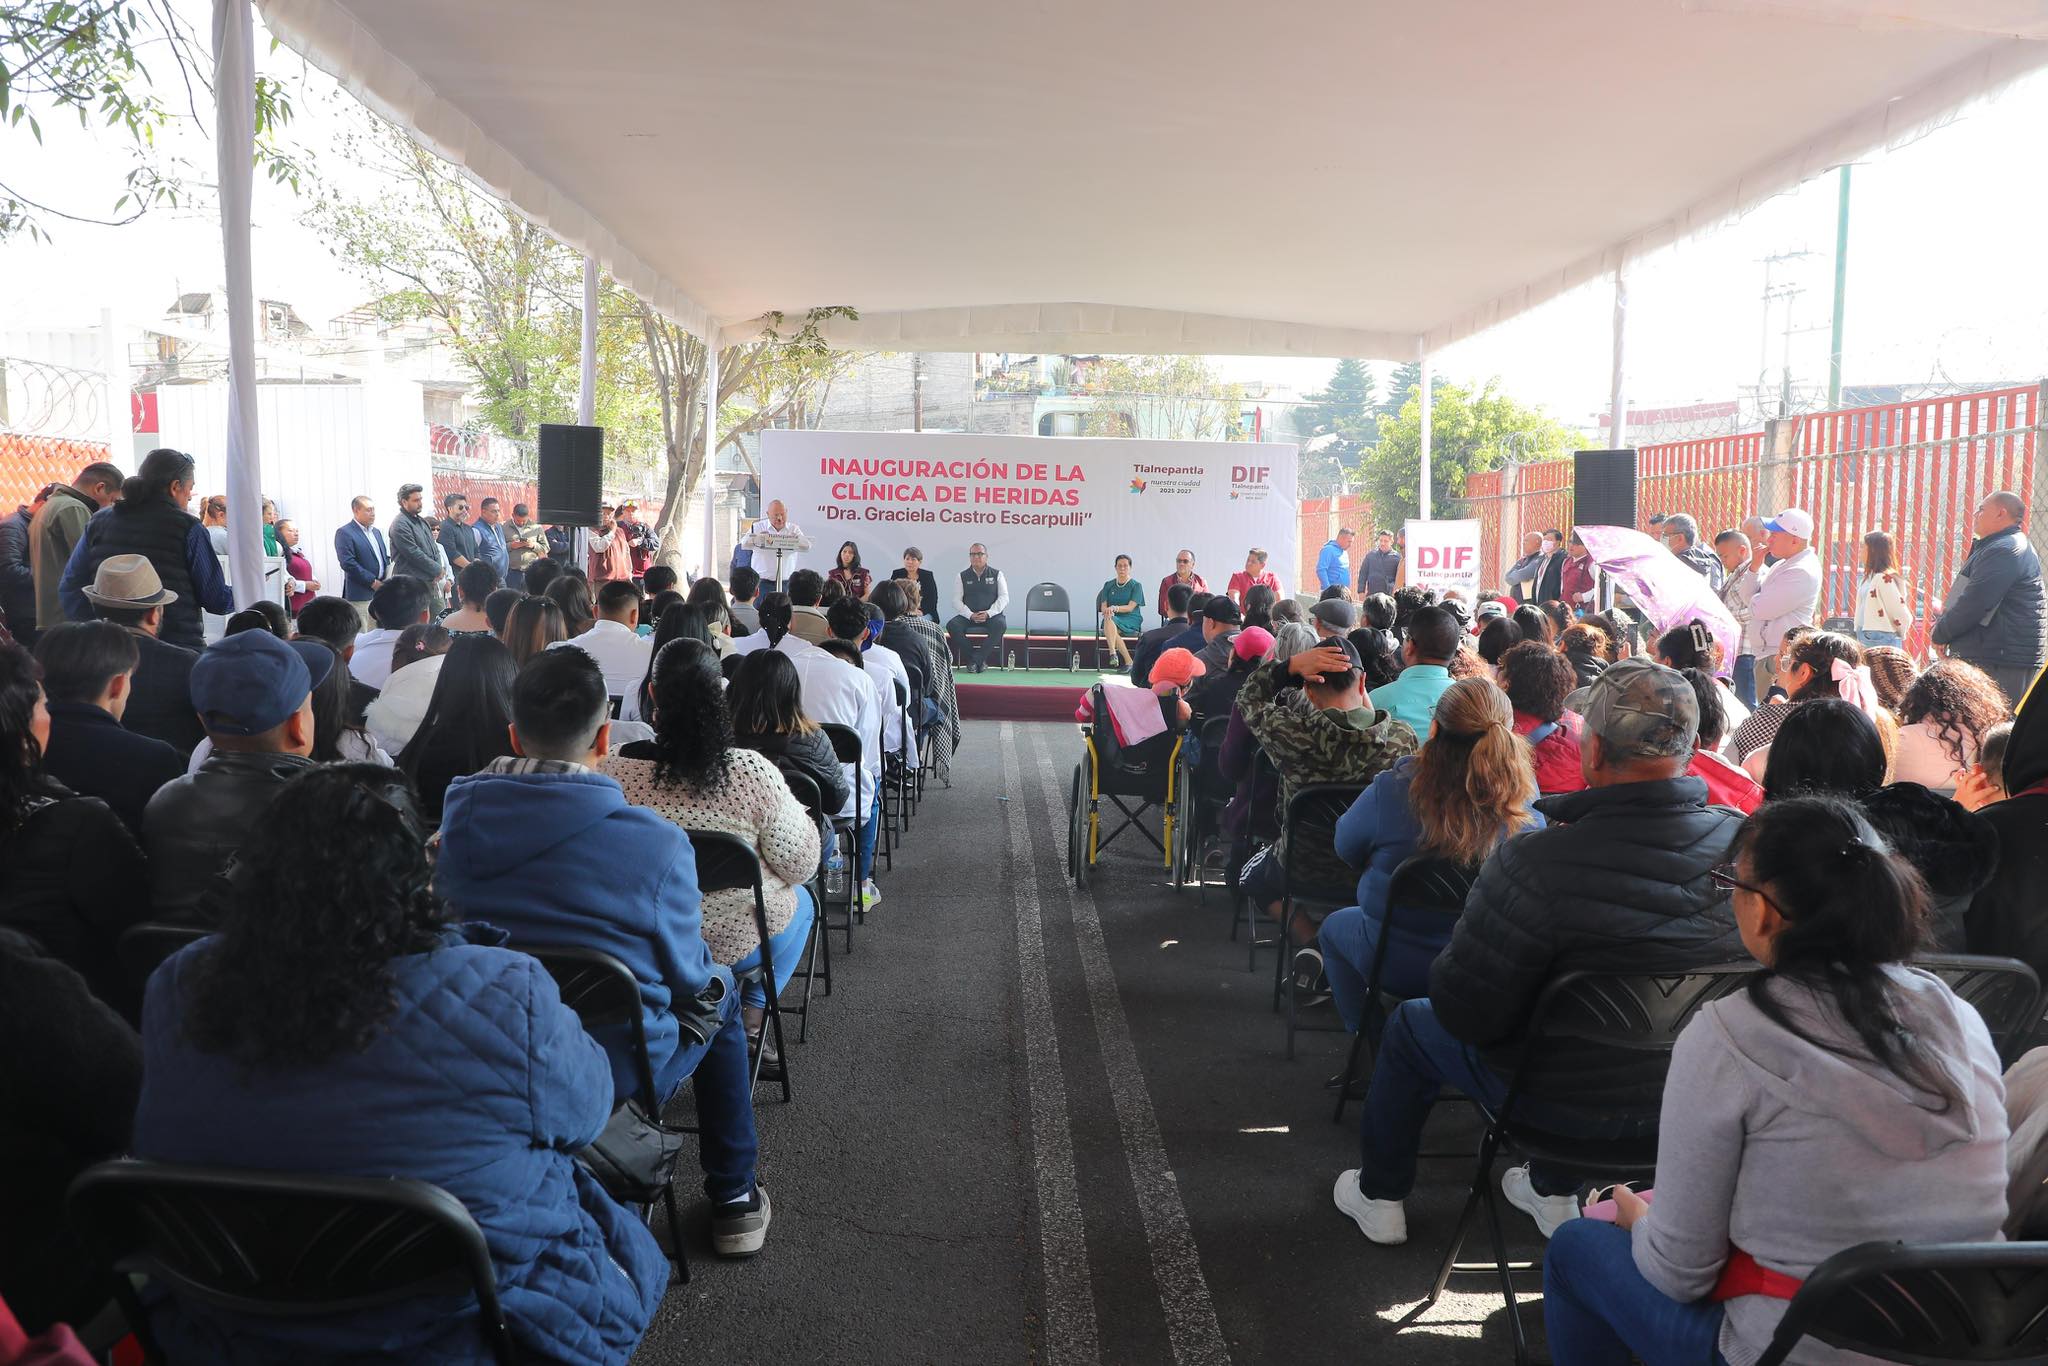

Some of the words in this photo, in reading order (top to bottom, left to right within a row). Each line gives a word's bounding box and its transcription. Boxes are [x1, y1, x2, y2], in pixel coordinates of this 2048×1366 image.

[821, 458, 1008, 480] INAUGURACIÓN
[1016, 463, 1048, 481] DE
[1055, 464, 1085, 482] LA
[1133, 464, 1204, 476] Tlalnepantla
[1231, 465, 1270, 483] DIF
[831, 479, 928, 502] CLÍNICA
[935, 486, 967, 503] DE
[974, 487, 1080, 506] HERIDAS
[1177, 480, 1201, 488] ciudad
[865, 506, 935, 523] Graciela
[939, 508, 996, 524] Castro
[1417, 546, 1474, 570] DIF
